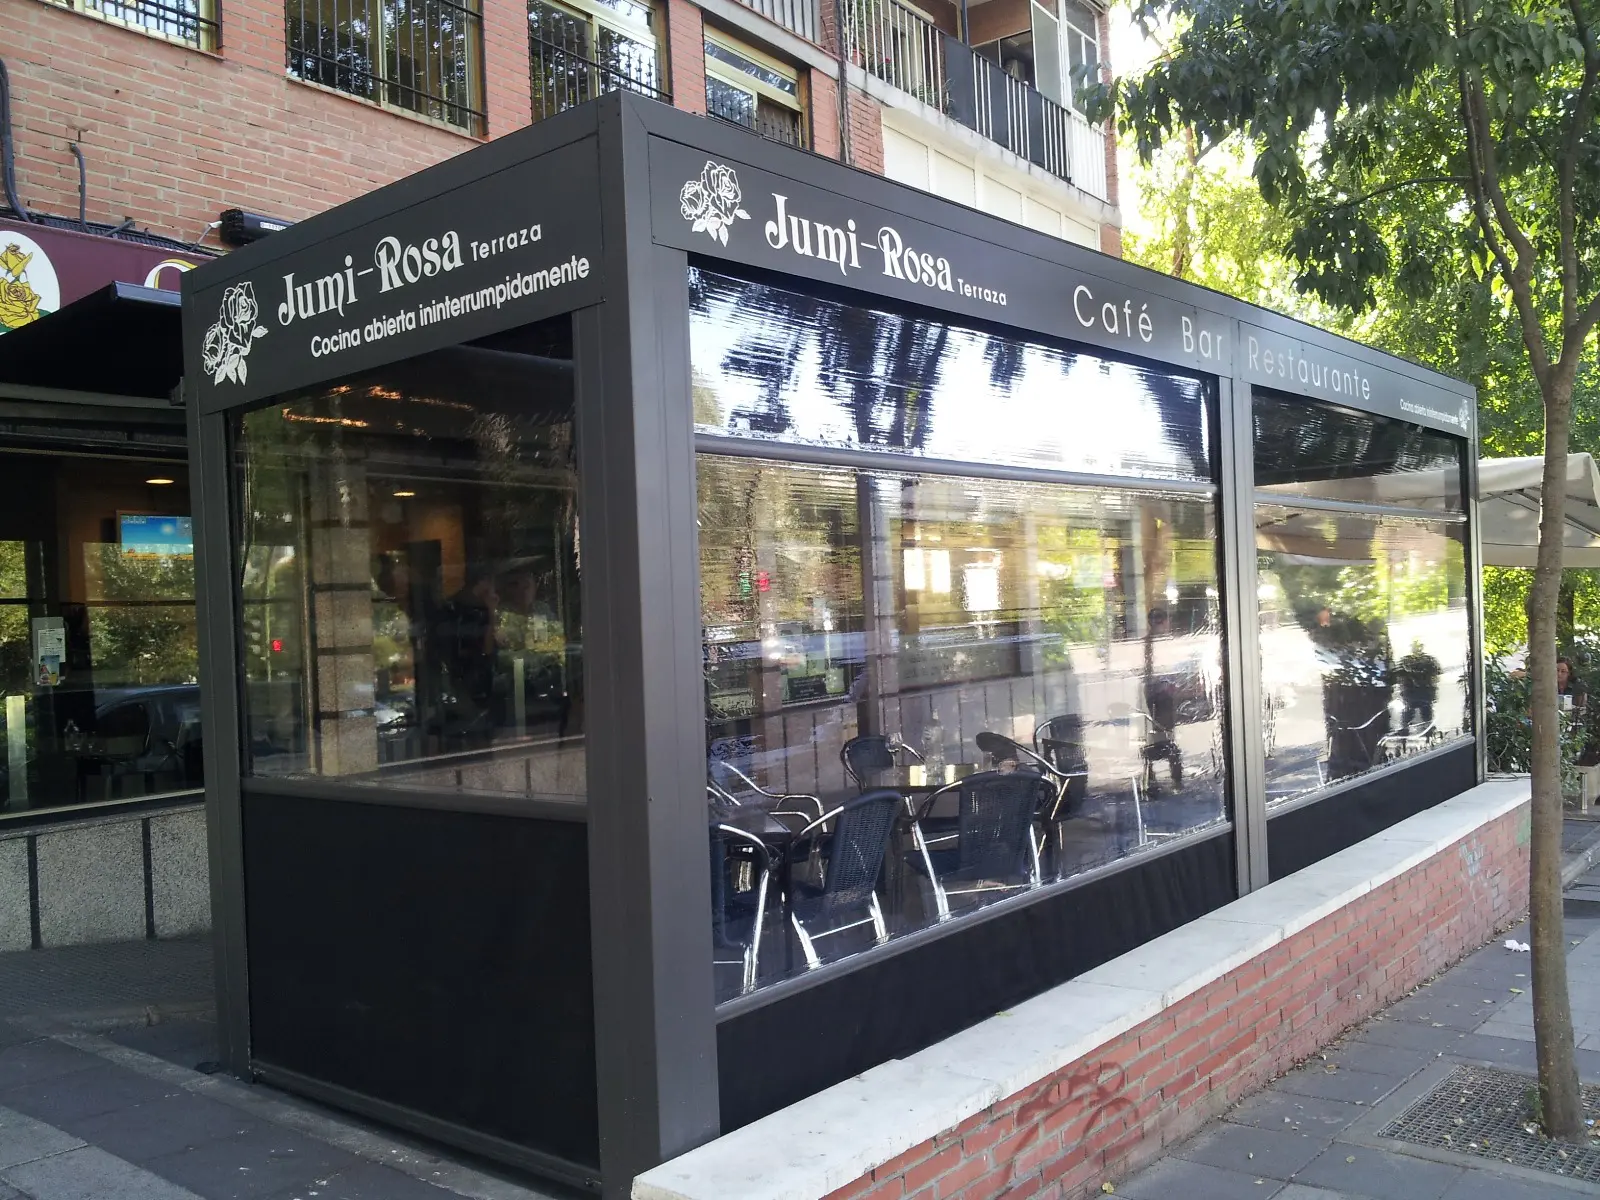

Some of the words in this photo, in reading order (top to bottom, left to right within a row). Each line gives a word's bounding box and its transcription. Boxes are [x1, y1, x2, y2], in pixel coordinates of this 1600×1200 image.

[278, 230, 465, 326] Jumi-Rosa
[470, 223, 542, 262] Terraza
[764, 193, 955, 293] Jumi-Rosa
[957, 278, 1007, 306] Terraza
[310, 328, 361, 358] Cocina
[363, 309, 417, 343] abierta
[419, 254, 590, 326] ininterrumpidamente
[1073, 285, 1153, 343] Café
[1180, 315, 1223, 361] Bar
[1249, 335, 1371, 400] Restaurante
